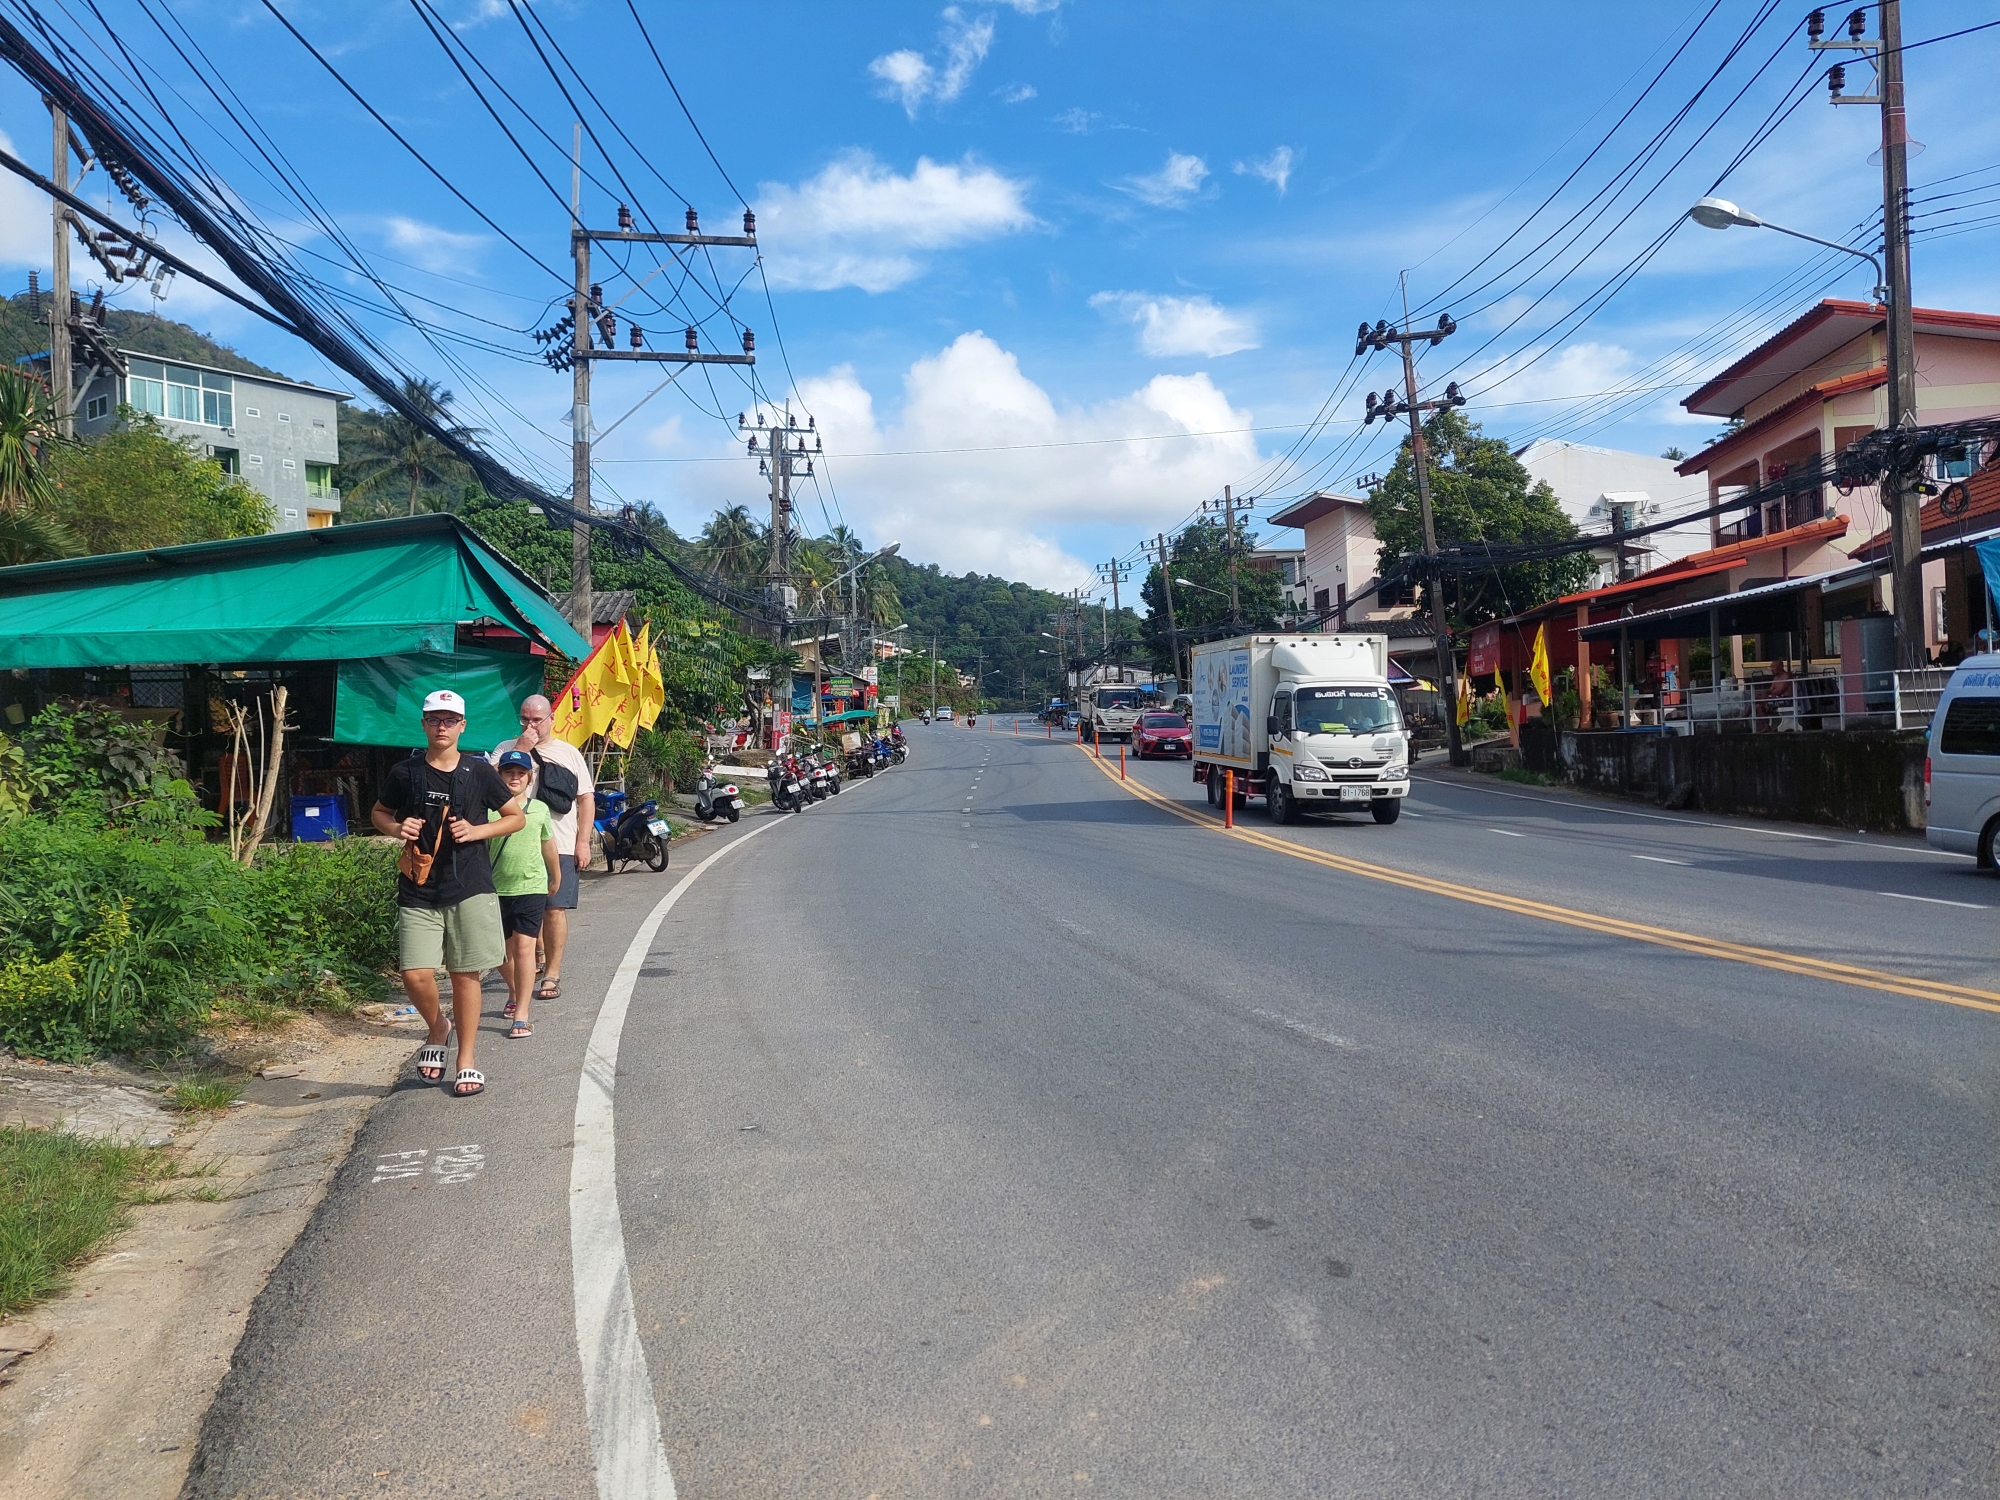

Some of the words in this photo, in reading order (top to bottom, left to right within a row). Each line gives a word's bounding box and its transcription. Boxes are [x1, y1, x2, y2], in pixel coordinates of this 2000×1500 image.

[1229, 663, 1248, 675] LAUNDRY
[1232, 676, 1248, 688] SERVICE
[1378, 688, 1389, 701] 5
[1342, 788, 1370, 797] 81-1768
[419, 1050, 445, 1063] NIKE
[456, 1071, 482, 1080] NIKE
